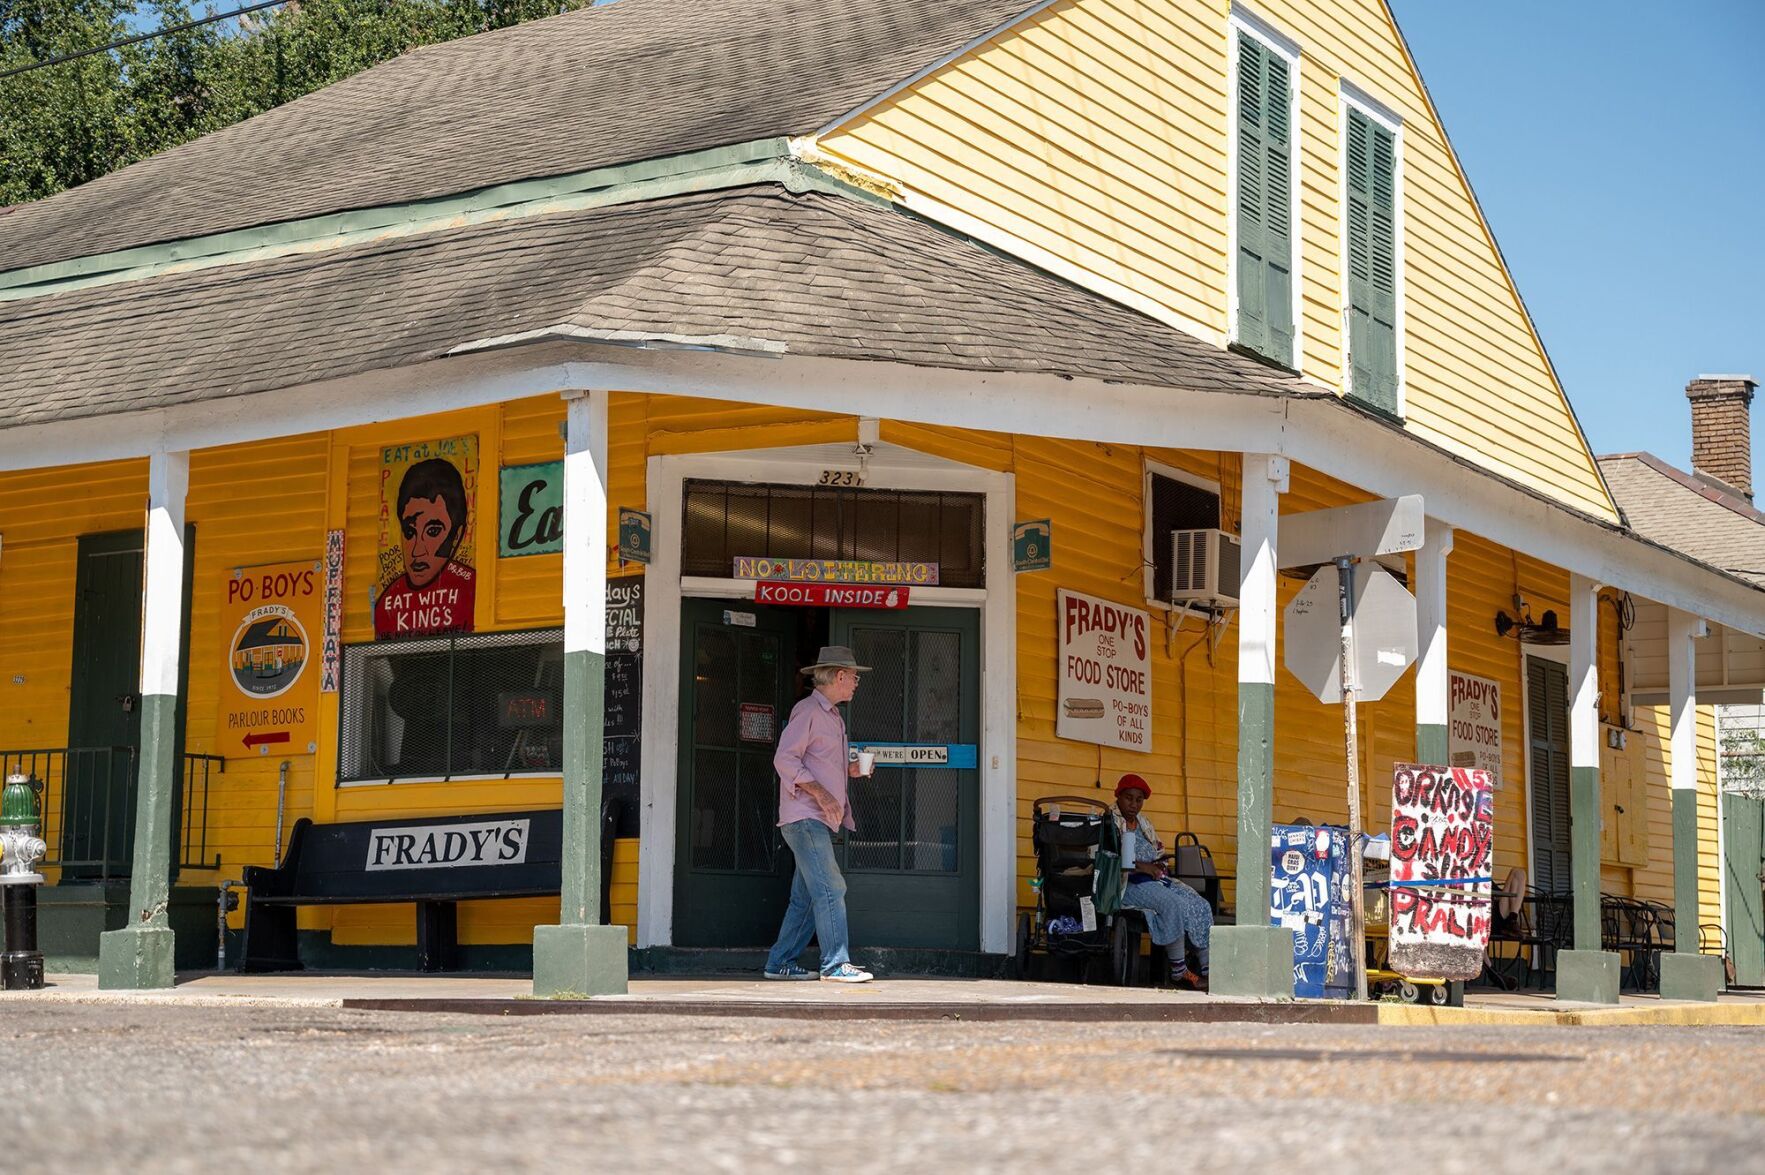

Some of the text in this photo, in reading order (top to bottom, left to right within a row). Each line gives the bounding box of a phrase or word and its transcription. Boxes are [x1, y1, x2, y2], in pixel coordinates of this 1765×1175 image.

[384, 446, 411, 464] EAT
[739, 559, 773, 578] NO
[788, 559, 929, 583] LOITERING
[384, 588, 459, 611] EAT WITH
[759, 586, 884, 605] KOOL INSIDE
[397, 604, 453, 632] KING'S
[1065, 595, 1146, 662] FRADY'S
[1098, 634, 1115, 648] ONE
[1096, 646, 1117, 660] STOP
[1067, 655, 1146, 695] FOOD STORE
[1112, 699, 1149, 718] PO-BOYS
[1450, 674, 1499, 721] FRADY'S
[228, 707, 305, 729] PARLOUR BOOKS
[1116, 714, 1144, 731] OF ALL
[1119, 730, 1143, 745] KINDS
[1452, 719, 1499, 747] FOOD STORE
[911, 749, 942, 760] OPEN
[372, 827, 523, 866] FRADY'S
[1392, 815, 1493, 870] CANDY
